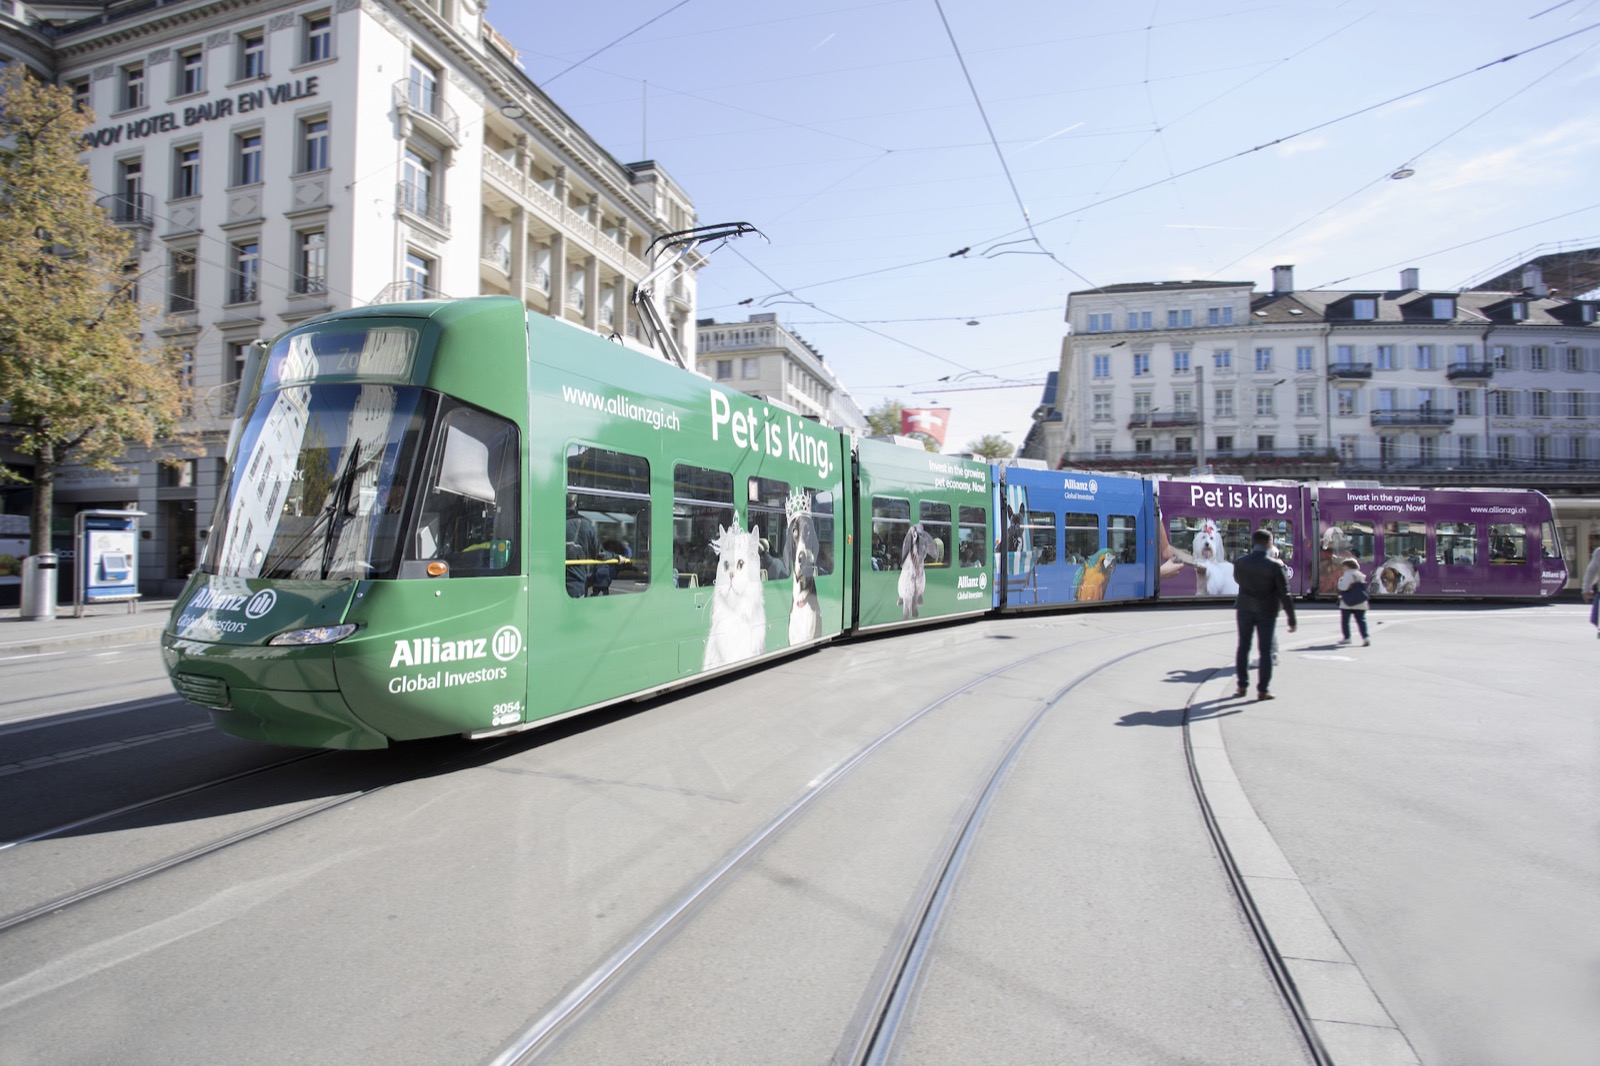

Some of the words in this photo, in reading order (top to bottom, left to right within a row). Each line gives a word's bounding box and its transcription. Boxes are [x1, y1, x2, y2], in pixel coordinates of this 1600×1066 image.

[127, 113, 180, 140] HOTEL
[185, 98, 233, 127] BAUR
[238, 89, 263, 113] EN
[267, 76, 319, 105] VILLE
[337, 348, 370, 371] Zoo
[562, 385, 680, 431] www.allianzgi.ch
[710, 389, 758, 451] Pet
[764, 407, 782, 457] is
[787, 416, 833, 479] king.
[929, 460, 947, 472] Invest
[948, 462, 954, 473] in
[954, 465, 963, 476] the
[964, 468, 986, 481] growing
[935, 478, 946, 488] pet
[946, 480, 971, 493] economy.
[973, 481, 986, 493] Now!
[1064, 479, 1088, 490] Allianz
[1191, 485, 1224, 507] Pet
[1228, 486, 1243, 507] is
[1248, 487, 1292, 514] king.
[1347, 493, 1370, 501] Invest
[1372, 493, 1378, 501] in
[1394, 494, 1426, 504] growing
[1354, 504, 1367, 512] pet
[1368, 504, 1404, 513] economy.
[1406, 504, 1426, 512] Now!
[1470, 506, 1527, 515] www.allianzgi.ch
[957, 576, 978, 589] Allianz
[189, 588, 248, 611] Allianz
[389, 636, 487, 668] Allianz
[388, 671, 441, 693] Global
[444, 667, 507, 687] Investors
[493, 701, 520, 715] 3054
